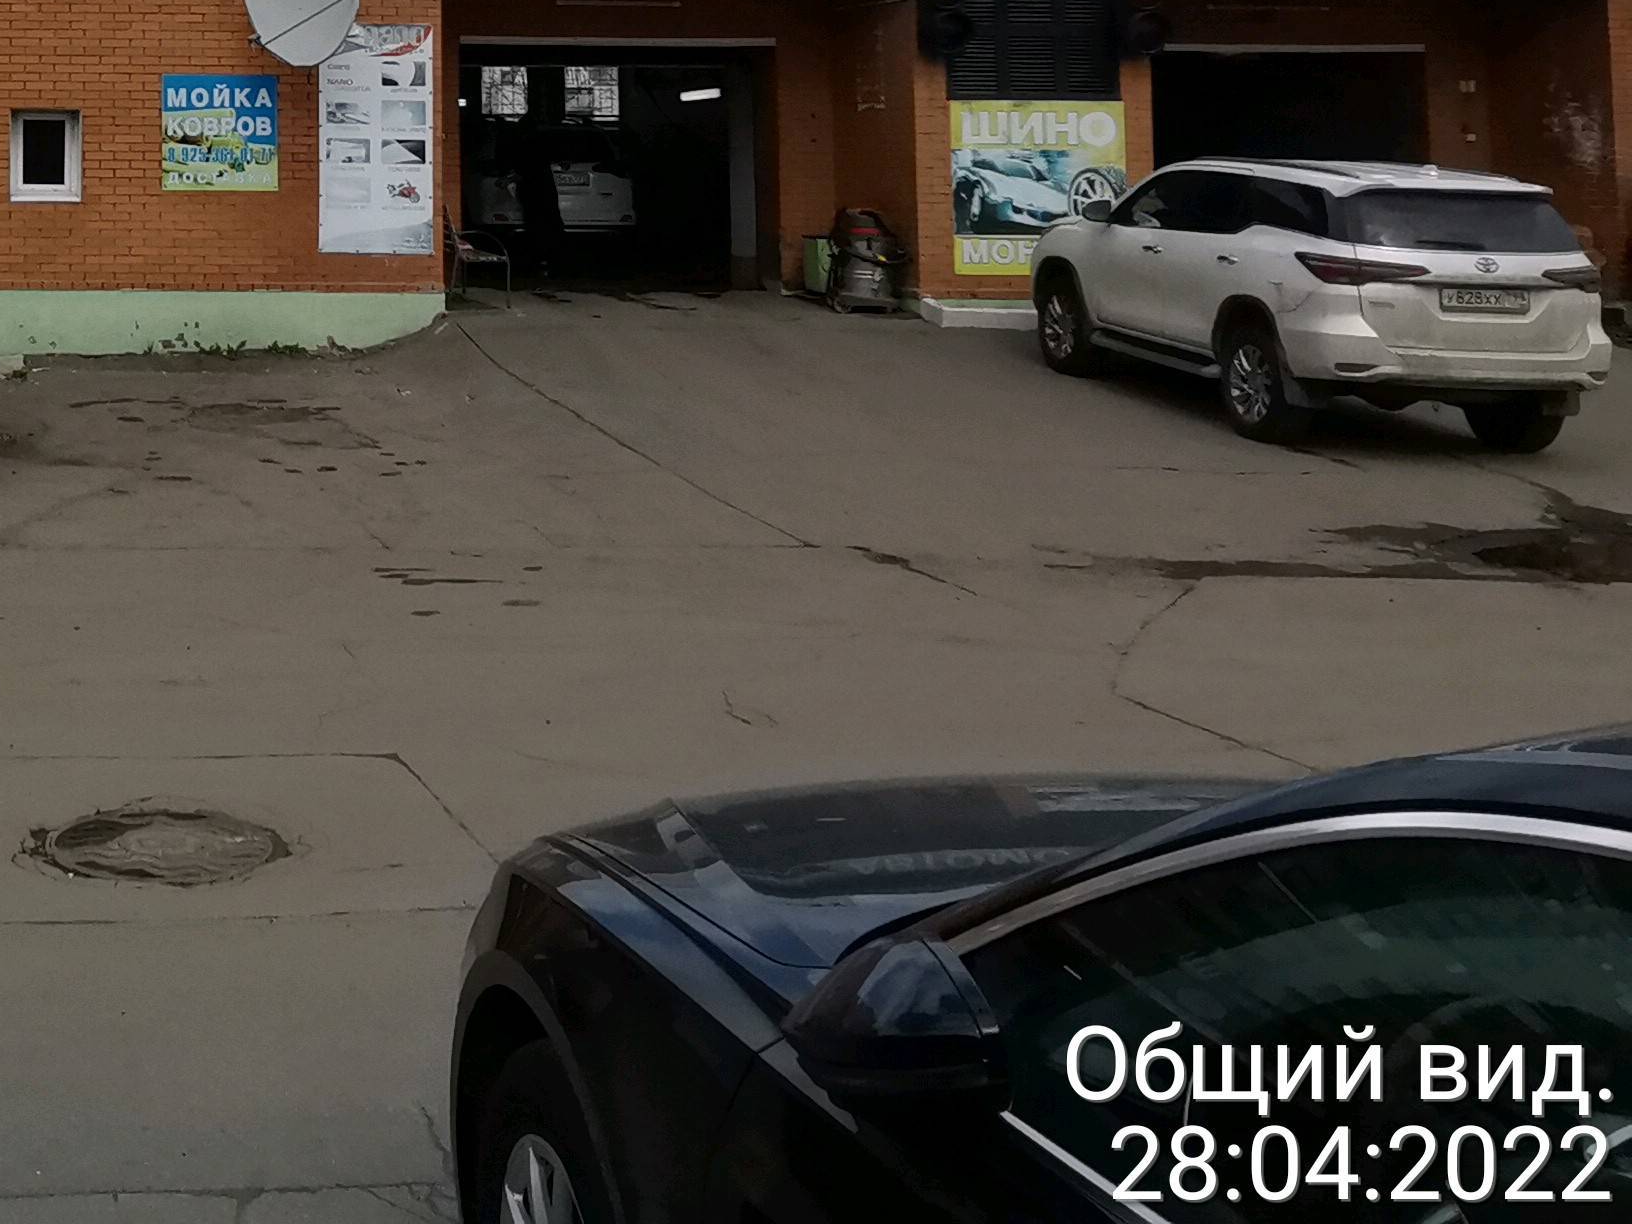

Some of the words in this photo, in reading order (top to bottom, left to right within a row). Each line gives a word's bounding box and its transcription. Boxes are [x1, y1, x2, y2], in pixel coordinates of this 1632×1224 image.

[166, 83, 273, 108] МОЙКА
[167, 116, 273, 138] КОВРОВ
[960, 111, 1117, 147] ШИНО
[963, 238, 1034, 265] МОН
